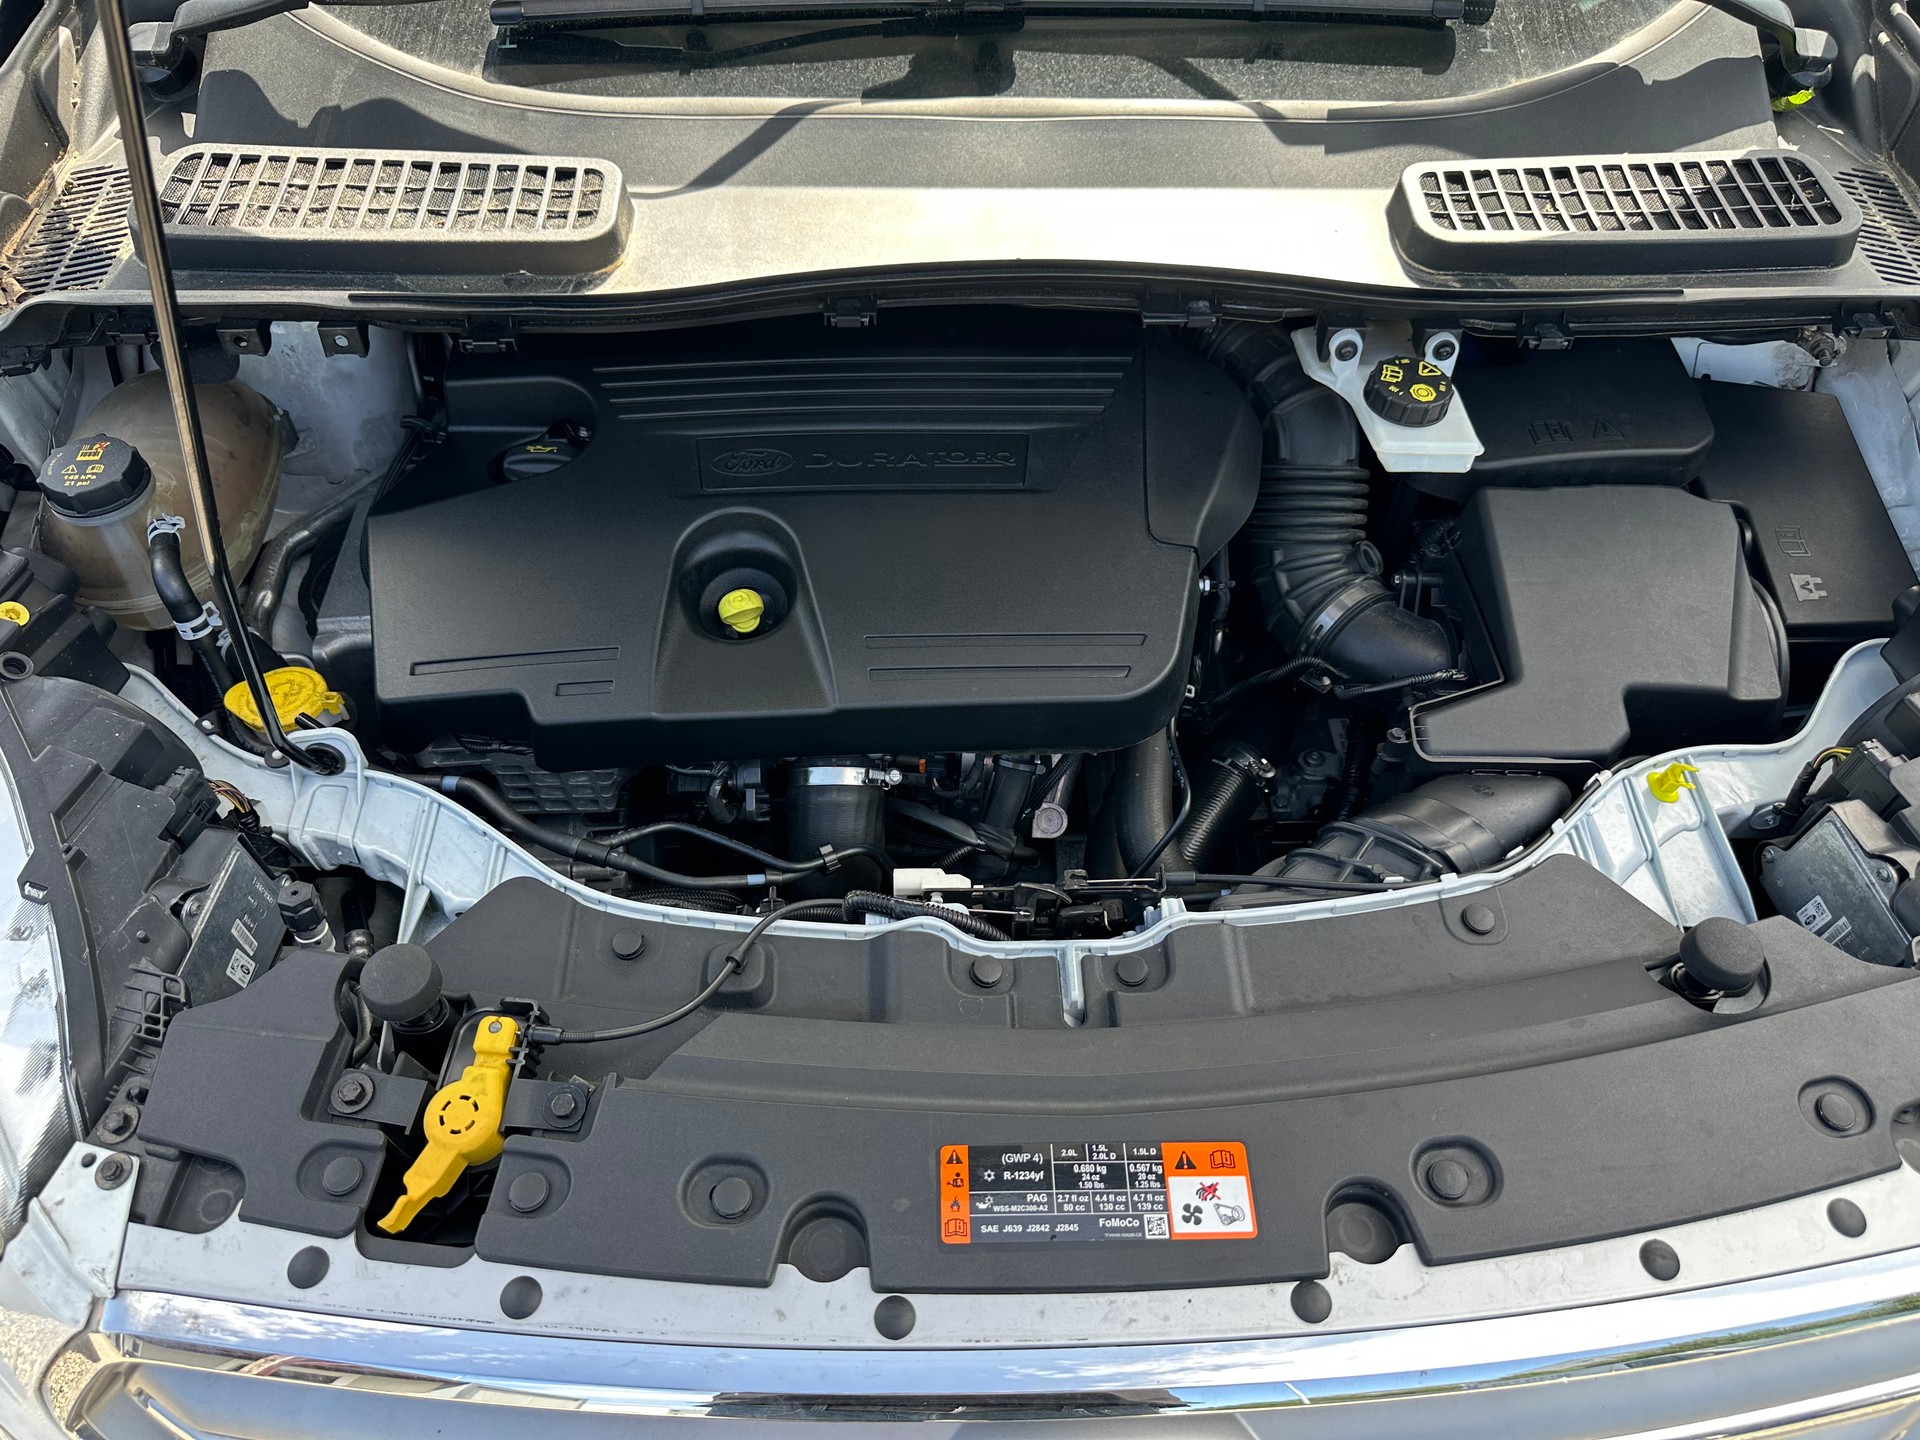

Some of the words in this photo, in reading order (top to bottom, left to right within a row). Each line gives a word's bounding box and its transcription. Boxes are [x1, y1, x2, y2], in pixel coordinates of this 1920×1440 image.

[725, 451, 780, 473] Ford
[805, 452, 1016, 469] DURATORQ
[1061, 1148, 1078, 1156] 2.0L
[1002, 1153, 1030, 1164] (GWP
[1032, 1153, 1043, 1164] 4)
[1073, 1164, 1095, 1172] 0.680
[1096, 1164, 1107, 1174] kg
[1129, 1164, 1150, 1172] 0.567
[1152, 1164, 1162, 1174] kg
[1004, 1171, 1044, 1182] R-1234yf
[1026, 1194, 1047, 1202] PAG
[1099, 1218, 1140, 1227] FoMoCo
[1055, 1224, 1078, 1232] J2845
